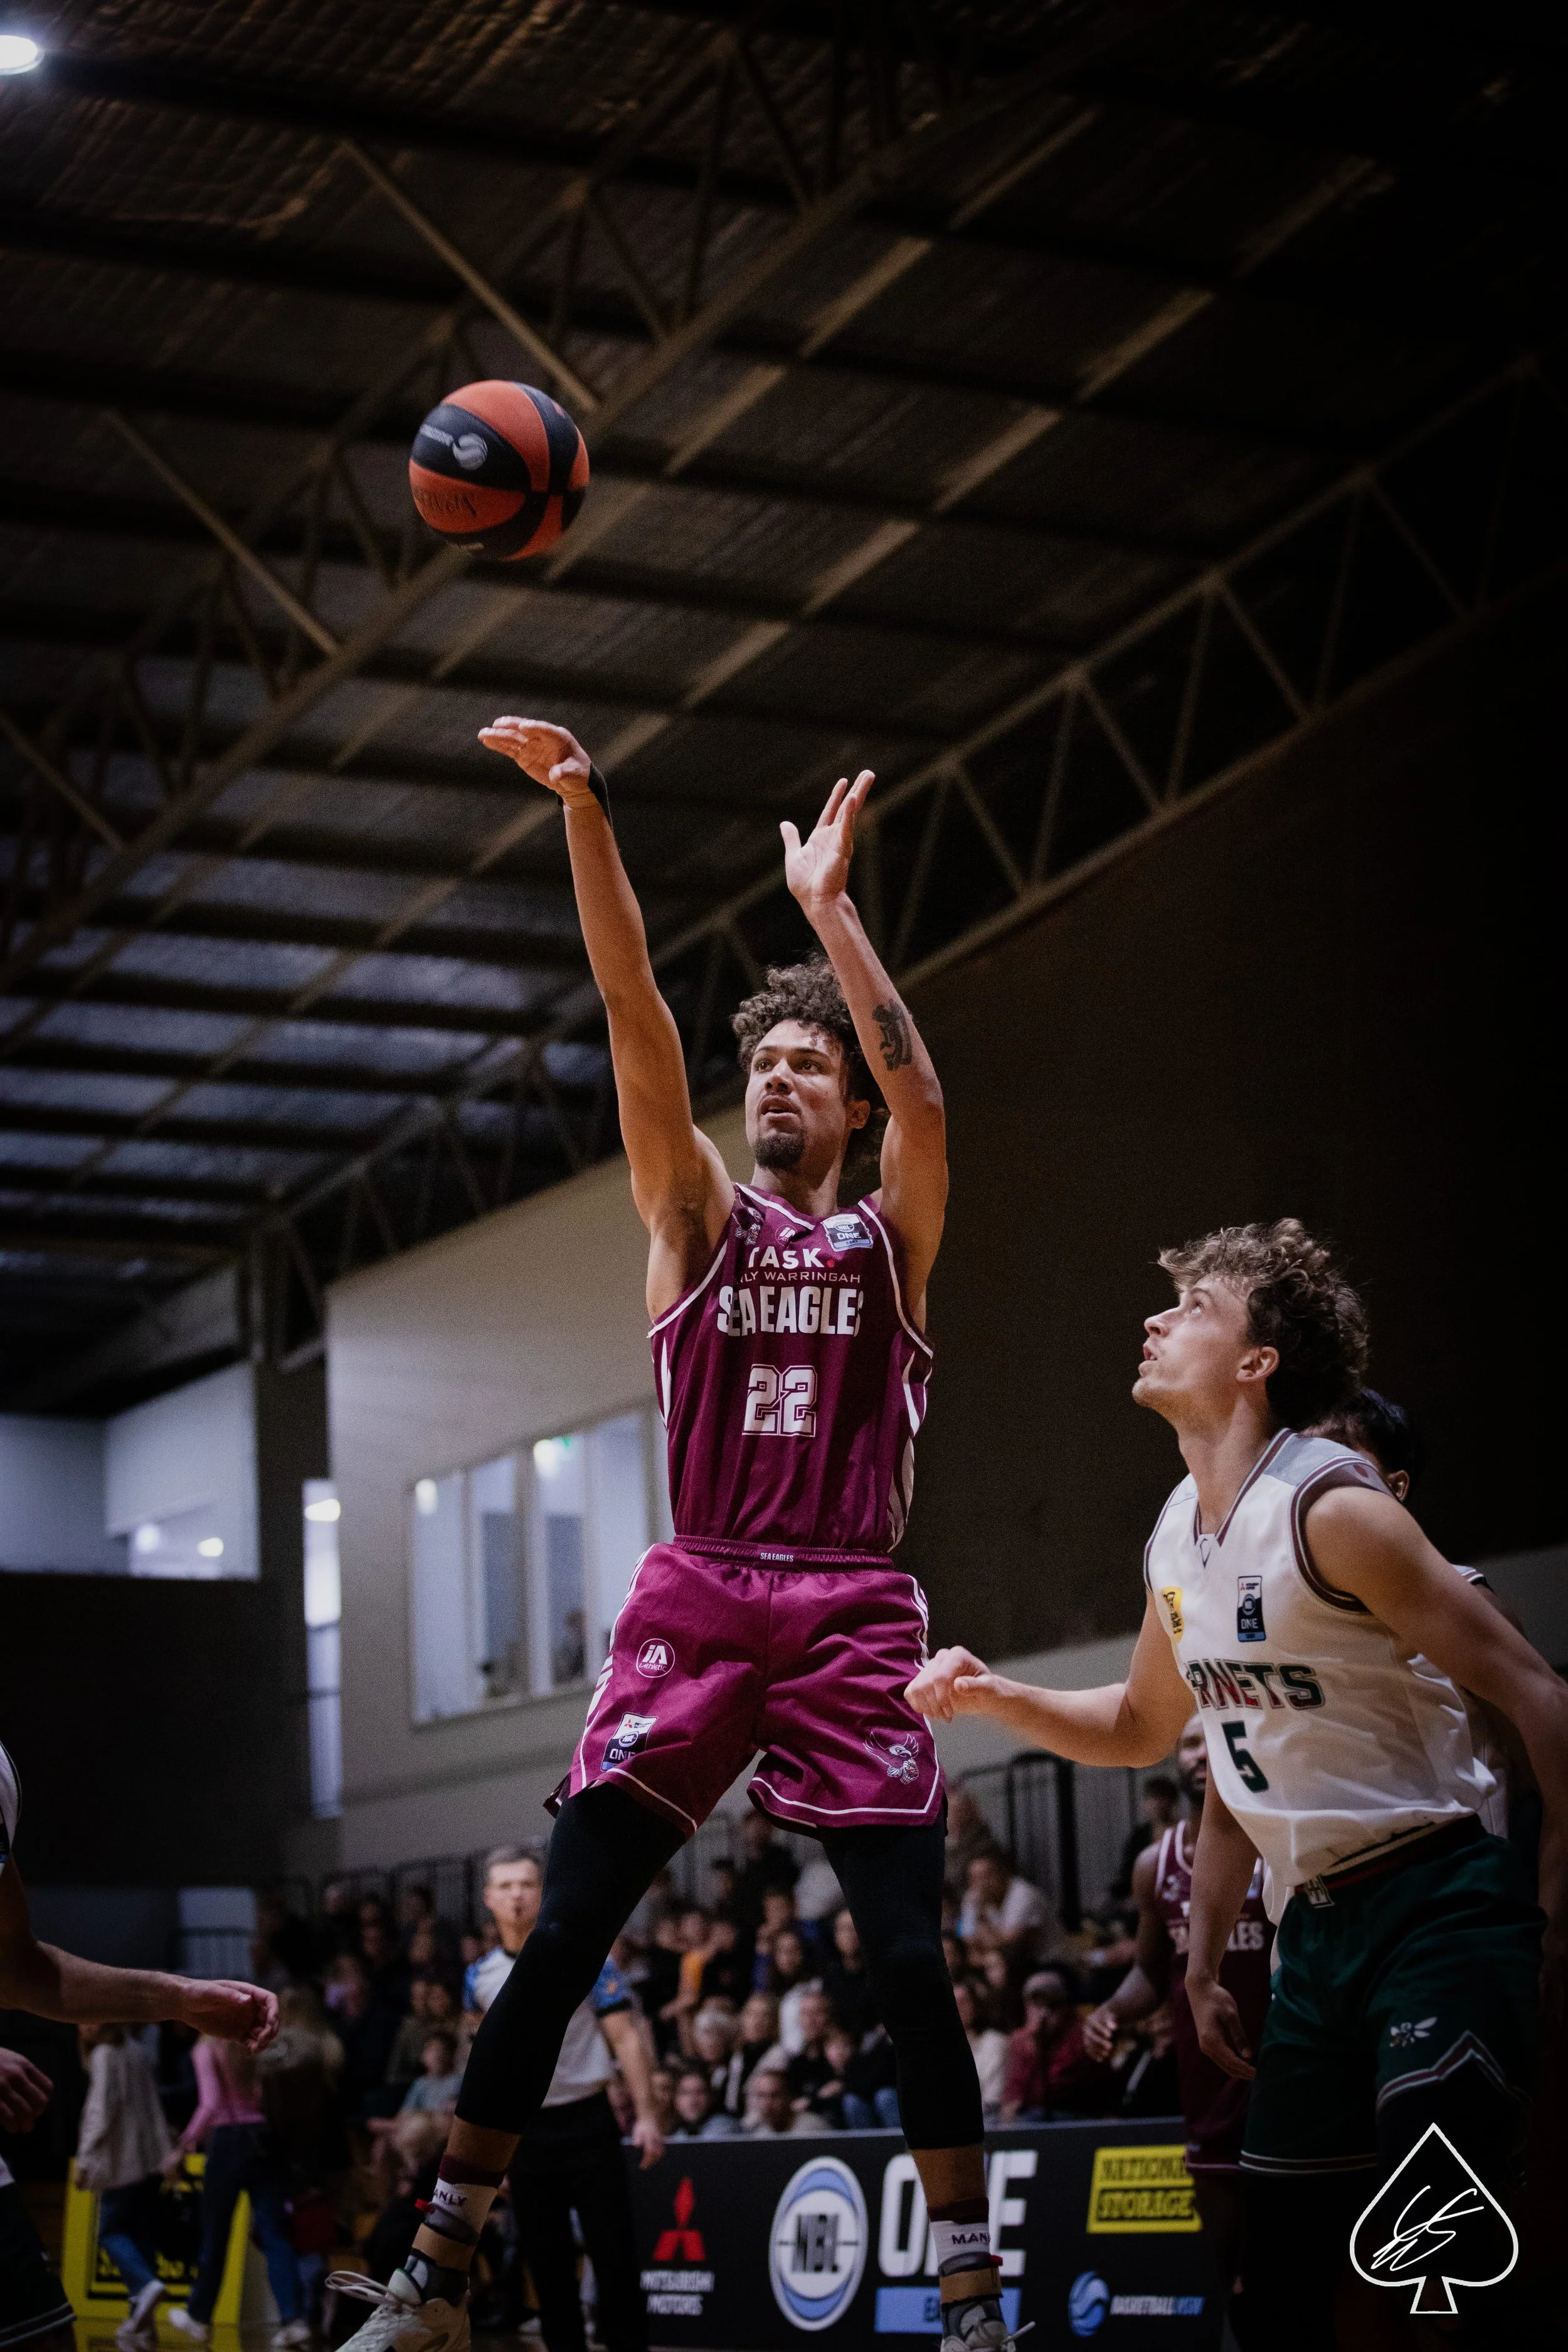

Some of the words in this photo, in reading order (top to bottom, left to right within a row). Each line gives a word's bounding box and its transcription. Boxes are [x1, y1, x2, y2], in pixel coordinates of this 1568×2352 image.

[764, 1271, 861, 1283] WARRINGAH
[742, 1364, 817, 1437] 22
[760, 1552, 771, 1560] SEA
[772, 1553, 793, 1562] EAGLES
[1241, 1618, 1259, 1629] ONE
[1185, 1658, 1325, 1711] RNETS
[1221, 1720, 1268, 1793] 5
[877, 2149, 1039, 2277] OE
[792, 2212, 839, 2272] NBL
